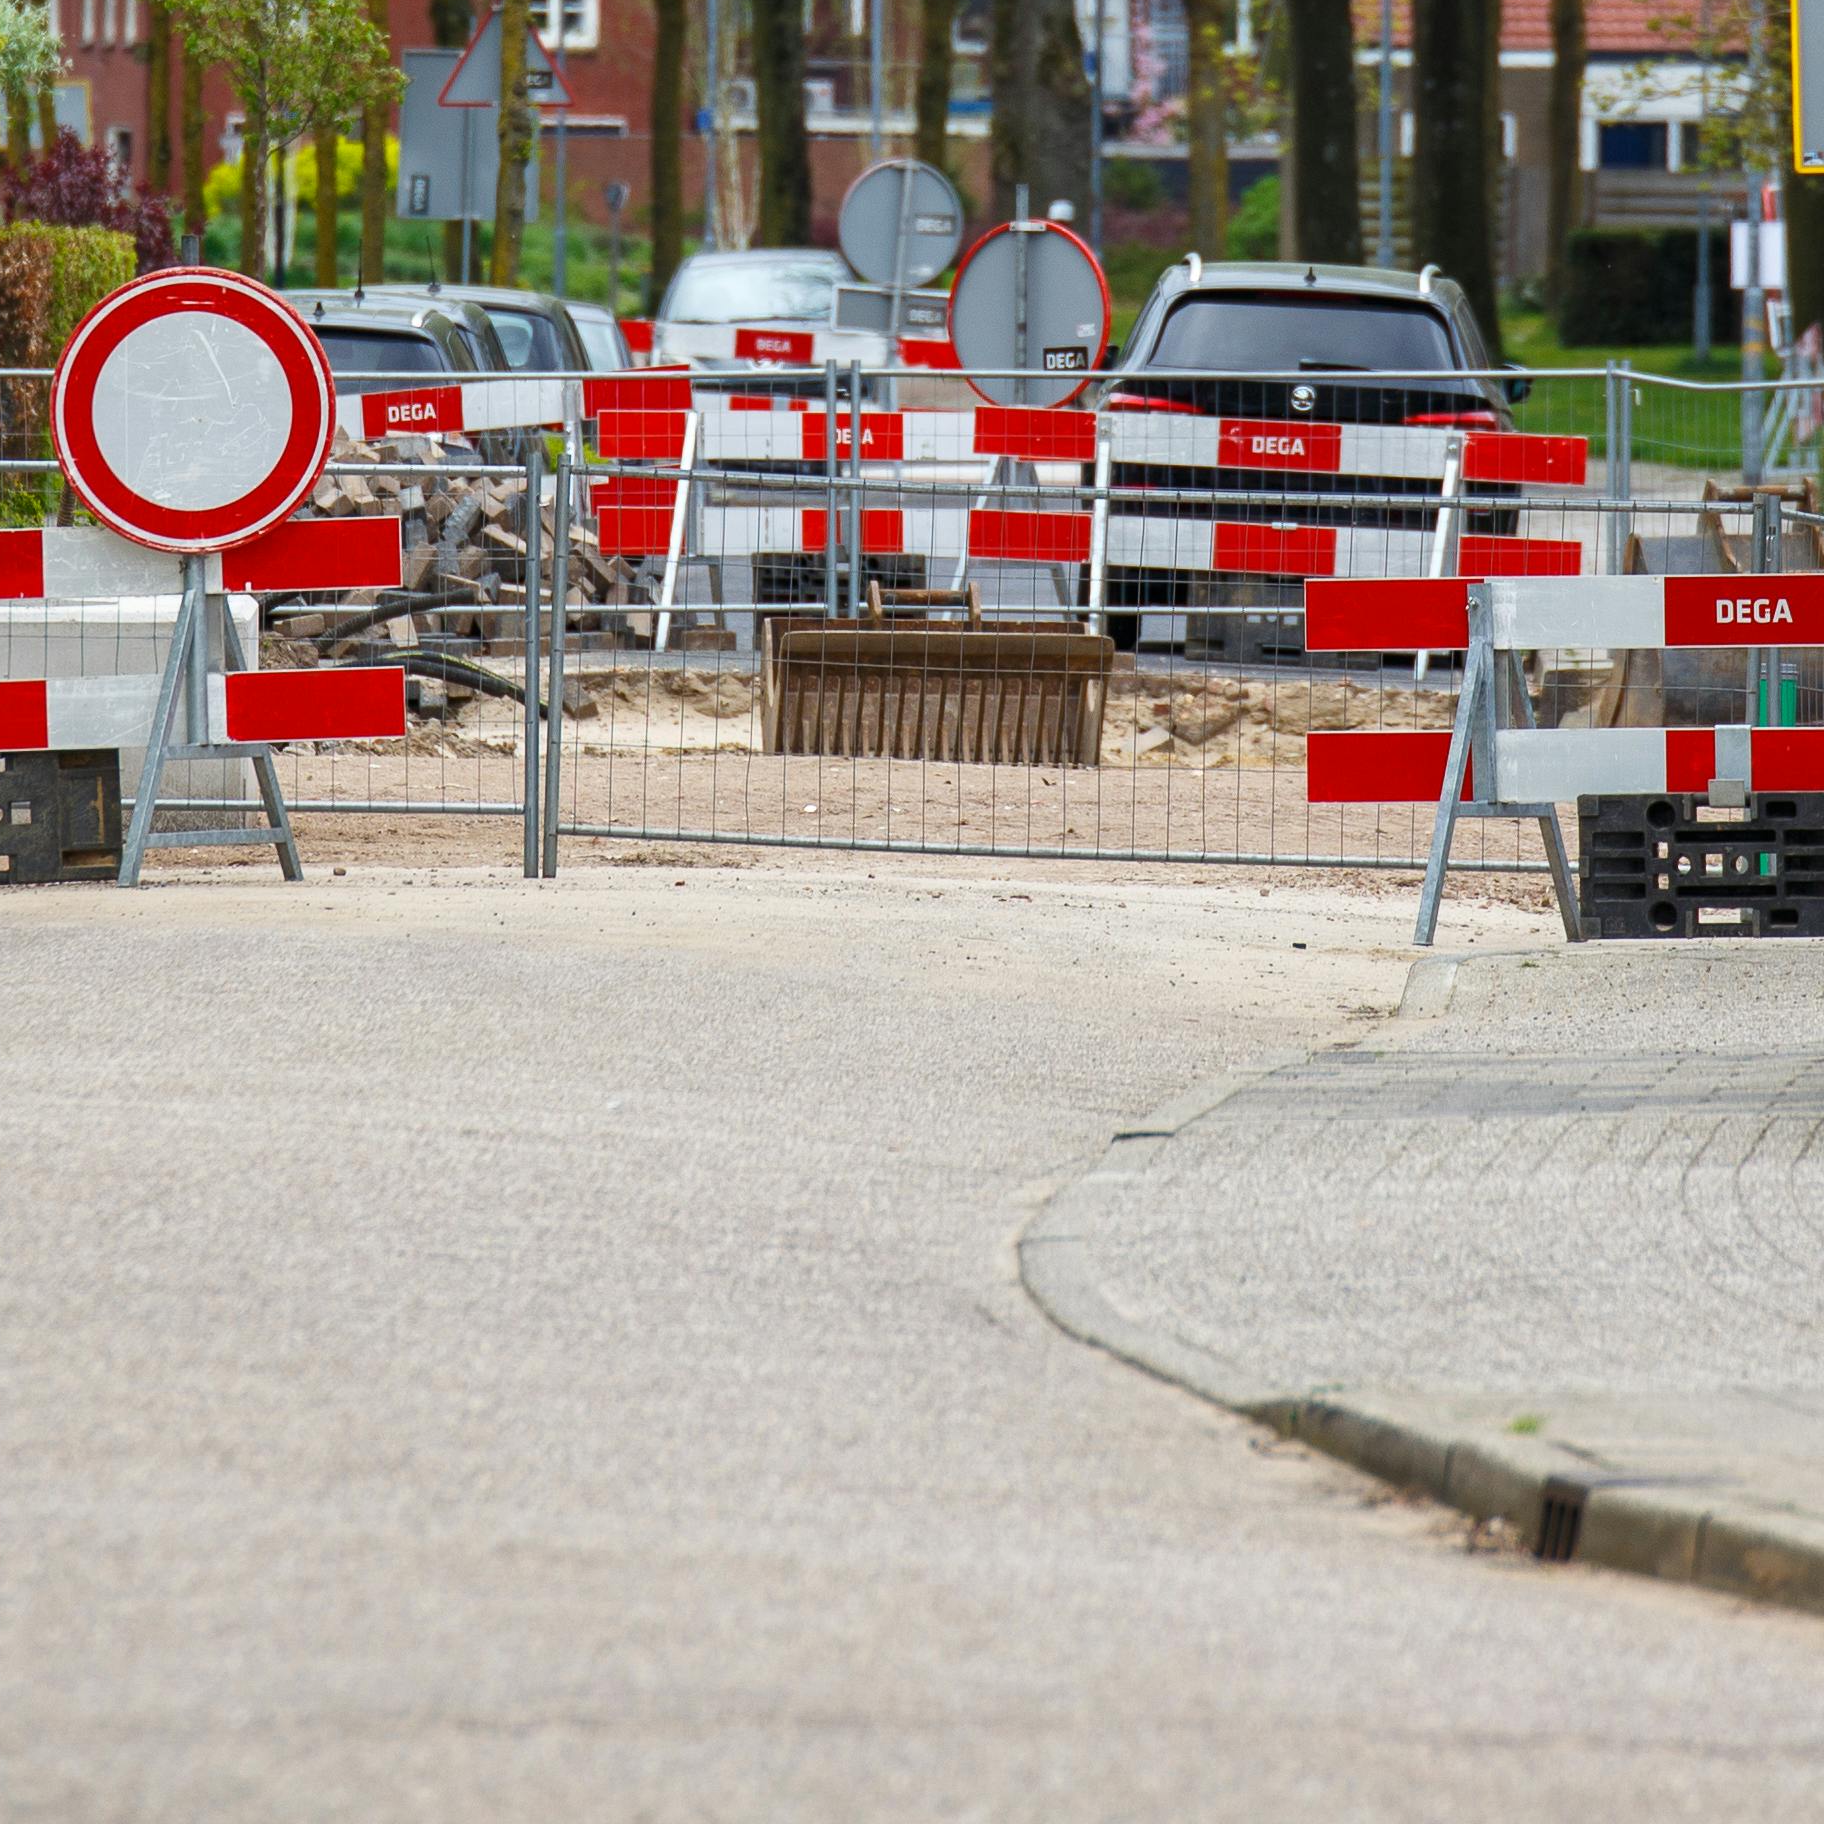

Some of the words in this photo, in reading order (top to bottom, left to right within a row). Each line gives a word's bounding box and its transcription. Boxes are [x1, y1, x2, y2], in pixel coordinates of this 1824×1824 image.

[1046, 352, 1086, 369] DEGA
[387, 402, 437, 423] DEGA
[1252, 436, 1305, 456] DEGA
[1716, 598, 1793, 624] DEGA
